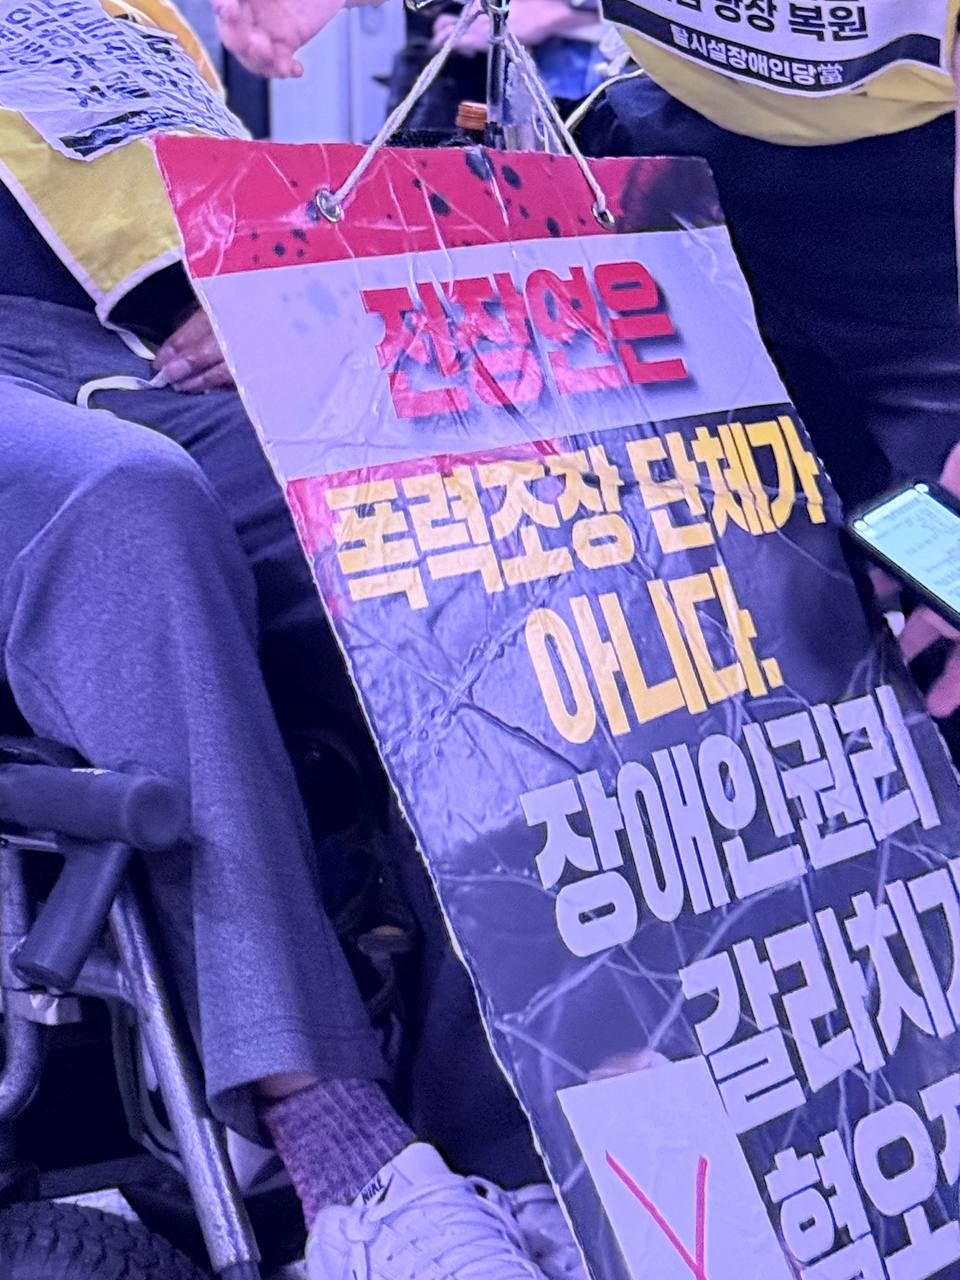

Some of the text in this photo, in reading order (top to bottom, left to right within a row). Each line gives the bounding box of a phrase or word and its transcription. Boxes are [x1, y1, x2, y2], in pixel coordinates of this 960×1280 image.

[787, 1, 870, 43] 복원
[360, 261, 688, 419] 전장연은
[326, 446, 637, 609] 폭력조장
[625, 414, 828, 556] 단체가
[524, 564, 784, 744] 아니다.
[519, 684, 941, 958] 장애인권리
[763, 1072, 960, 1280] 혐오
